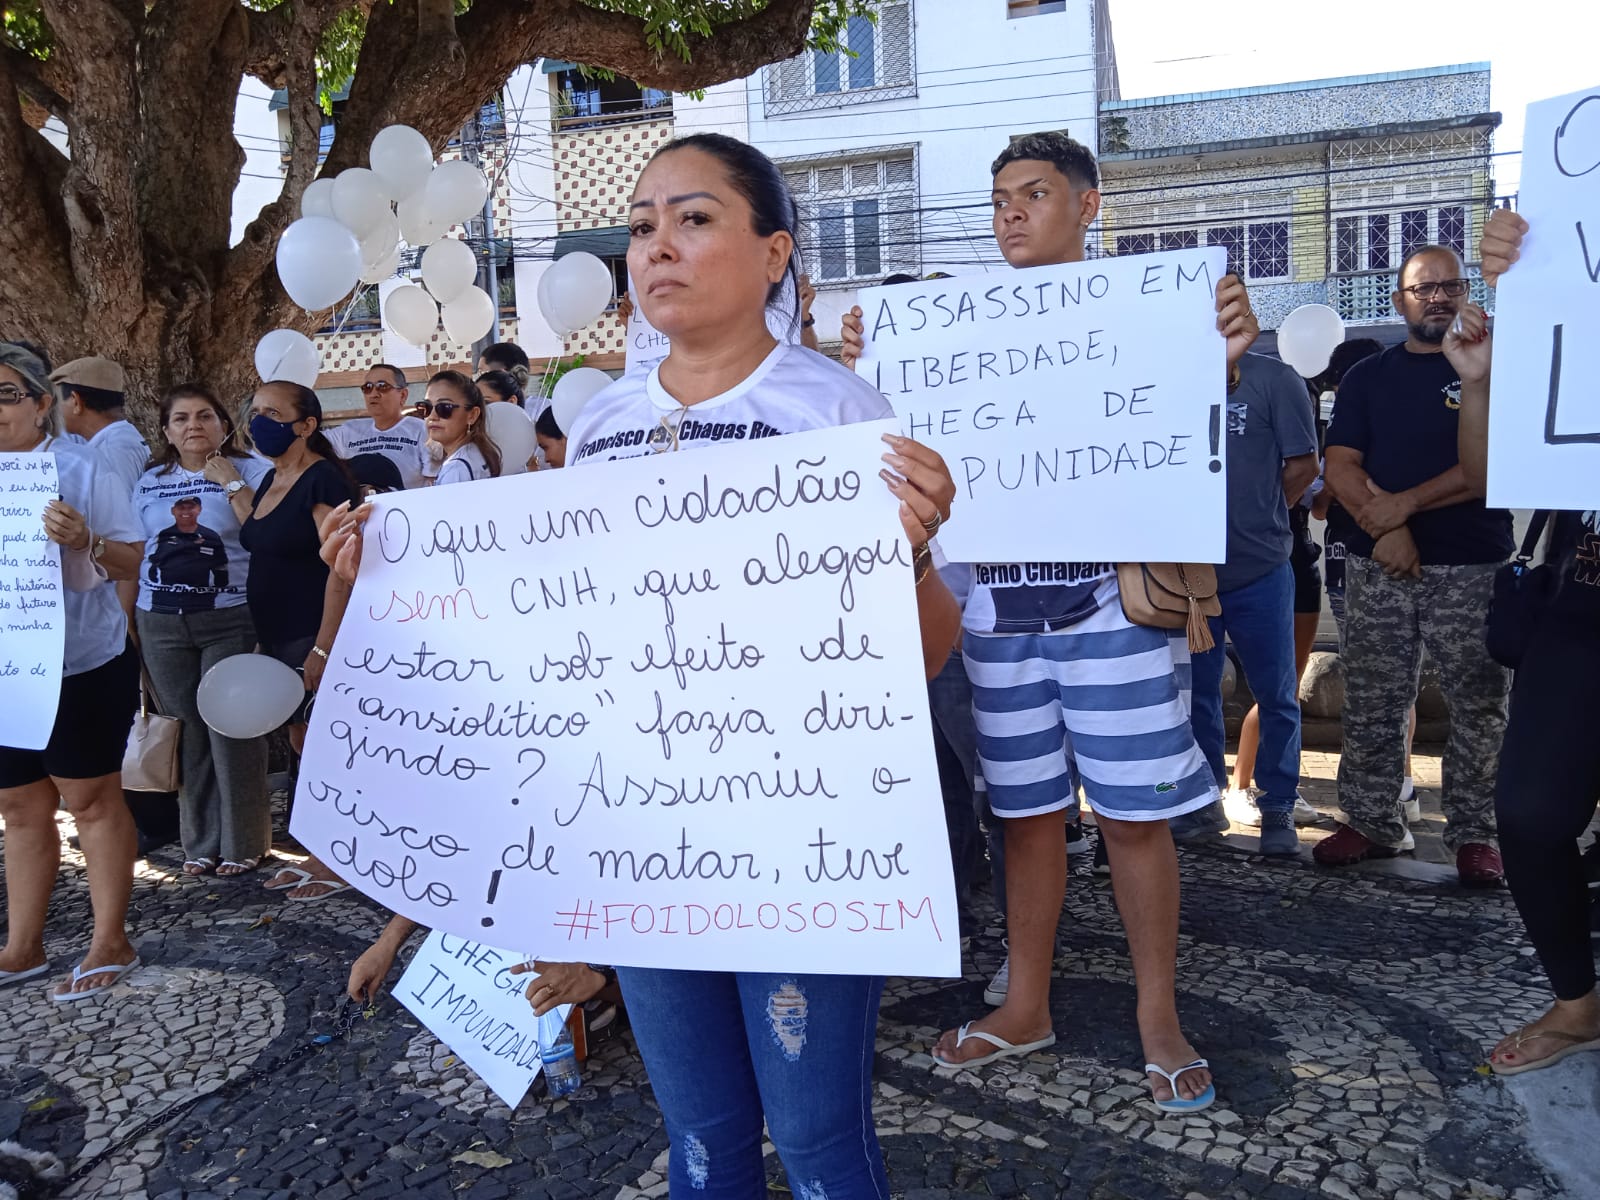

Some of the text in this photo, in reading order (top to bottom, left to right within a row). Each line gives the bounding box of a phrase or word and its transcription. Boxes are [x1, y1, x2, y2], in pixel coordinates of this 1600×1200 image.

[872, 261, 1214, 342] ASSASSINO EM
[876, 330, 1118, 396] LIBERDADE,
[679, 420, 747, 441] Chagas
[903, 384, 1156, 440] HEGA DE
[961, 403, 1222, 500] PUNIDADE!
[30, 480, 60, 493] sent
[32, 528, 50, 542] da
[379, 456, 861, 586] O que um cidadão
[25, 554, 59, 568] vida
[369, 532, 911, 626] sem CNH, que alegou
[8, 620, 52, 631] minha
[344, 617, 884, 690] estar sob efeito de
[30, 662, 47, 676] de
[636, 690, 775, 760] fazia
[804, 689, 915, 735] diri-
[555, 751, 839, 827] Assumiu
[872, 766, 912, 794] o
[308, 780, 910, 884] risco de matar, teve
[553, 896, 943, 943] #FOIDOLOSOSIM
